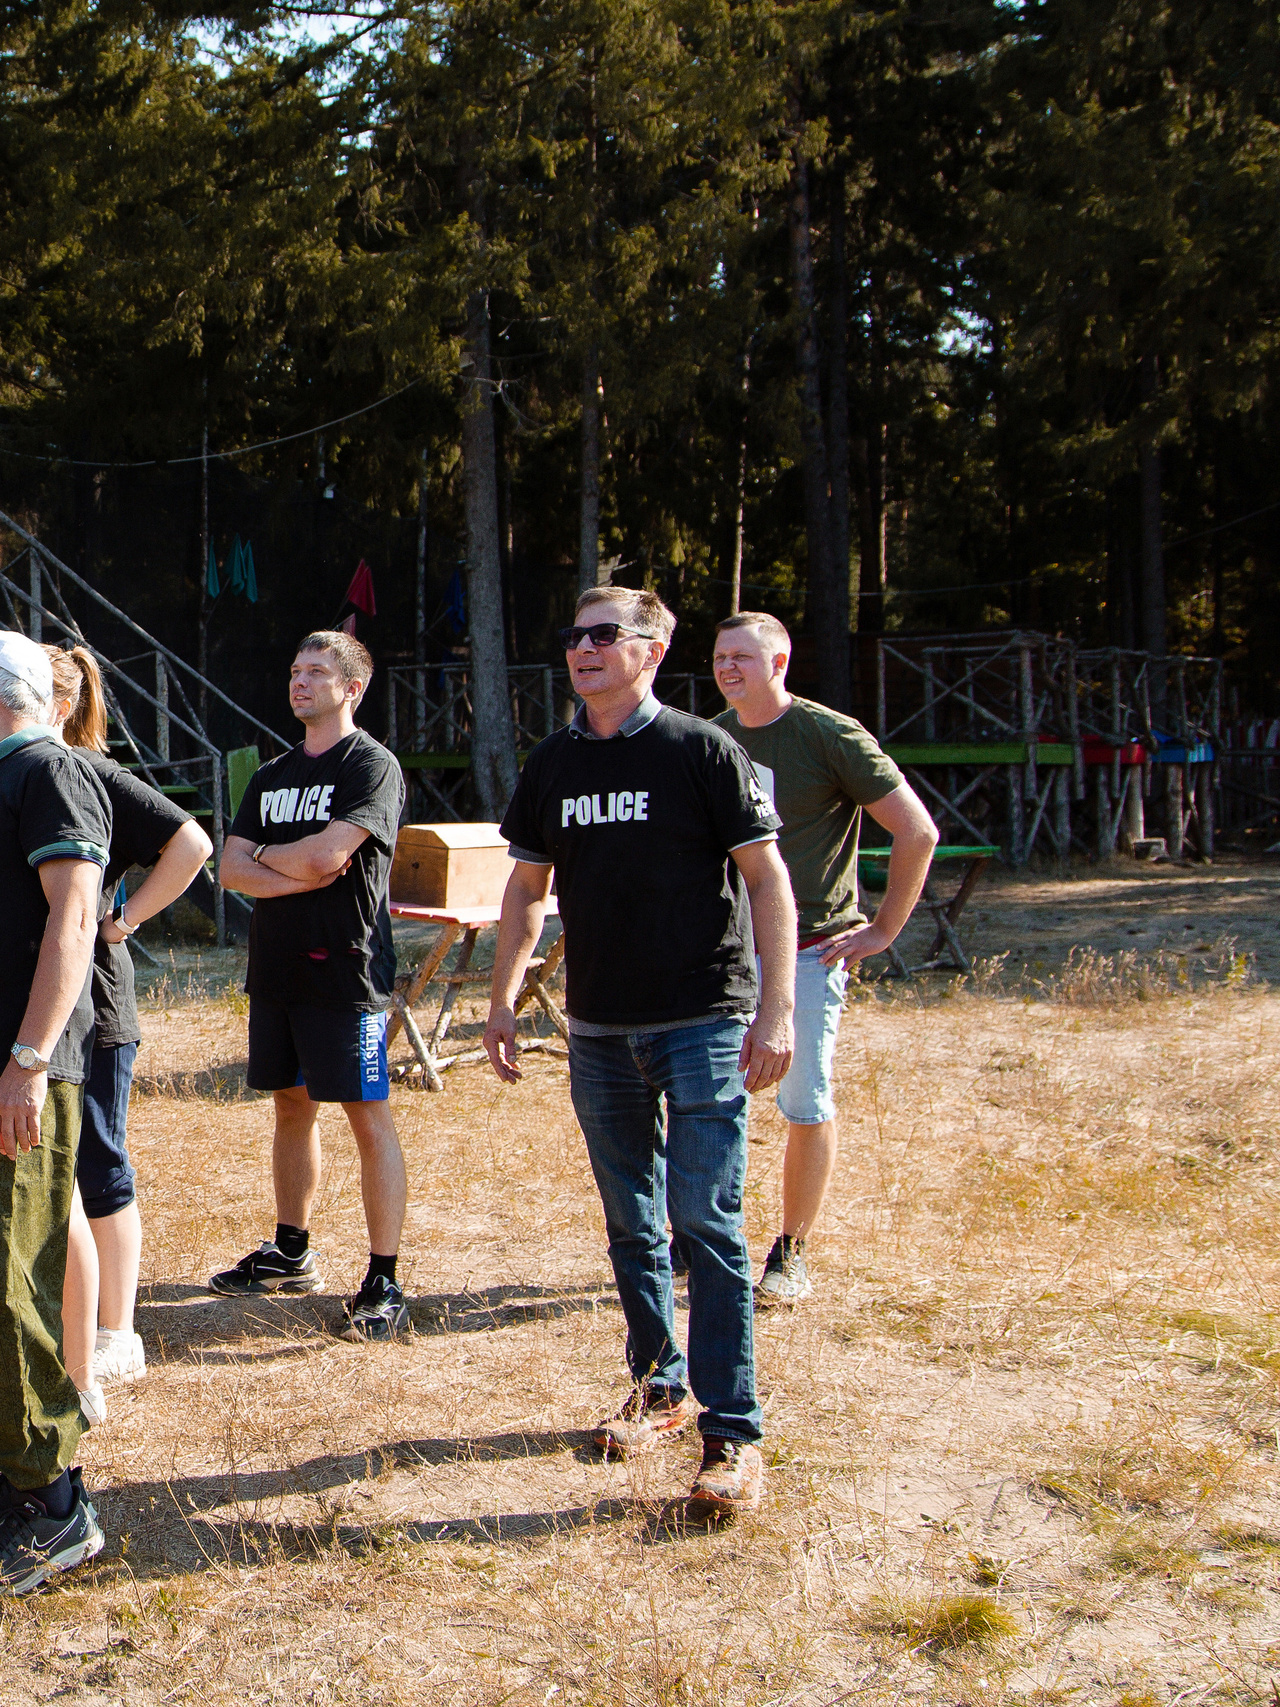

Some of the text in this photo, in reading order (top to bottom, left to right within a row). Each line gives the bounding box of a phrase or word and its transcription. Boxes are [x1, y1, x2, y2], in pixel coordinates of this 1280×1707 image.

[261, 785, 335, 827] POLICE
[561, 791, 649, 828] POLICE
[365, 1014, 380, 1083] HOLLISTER
